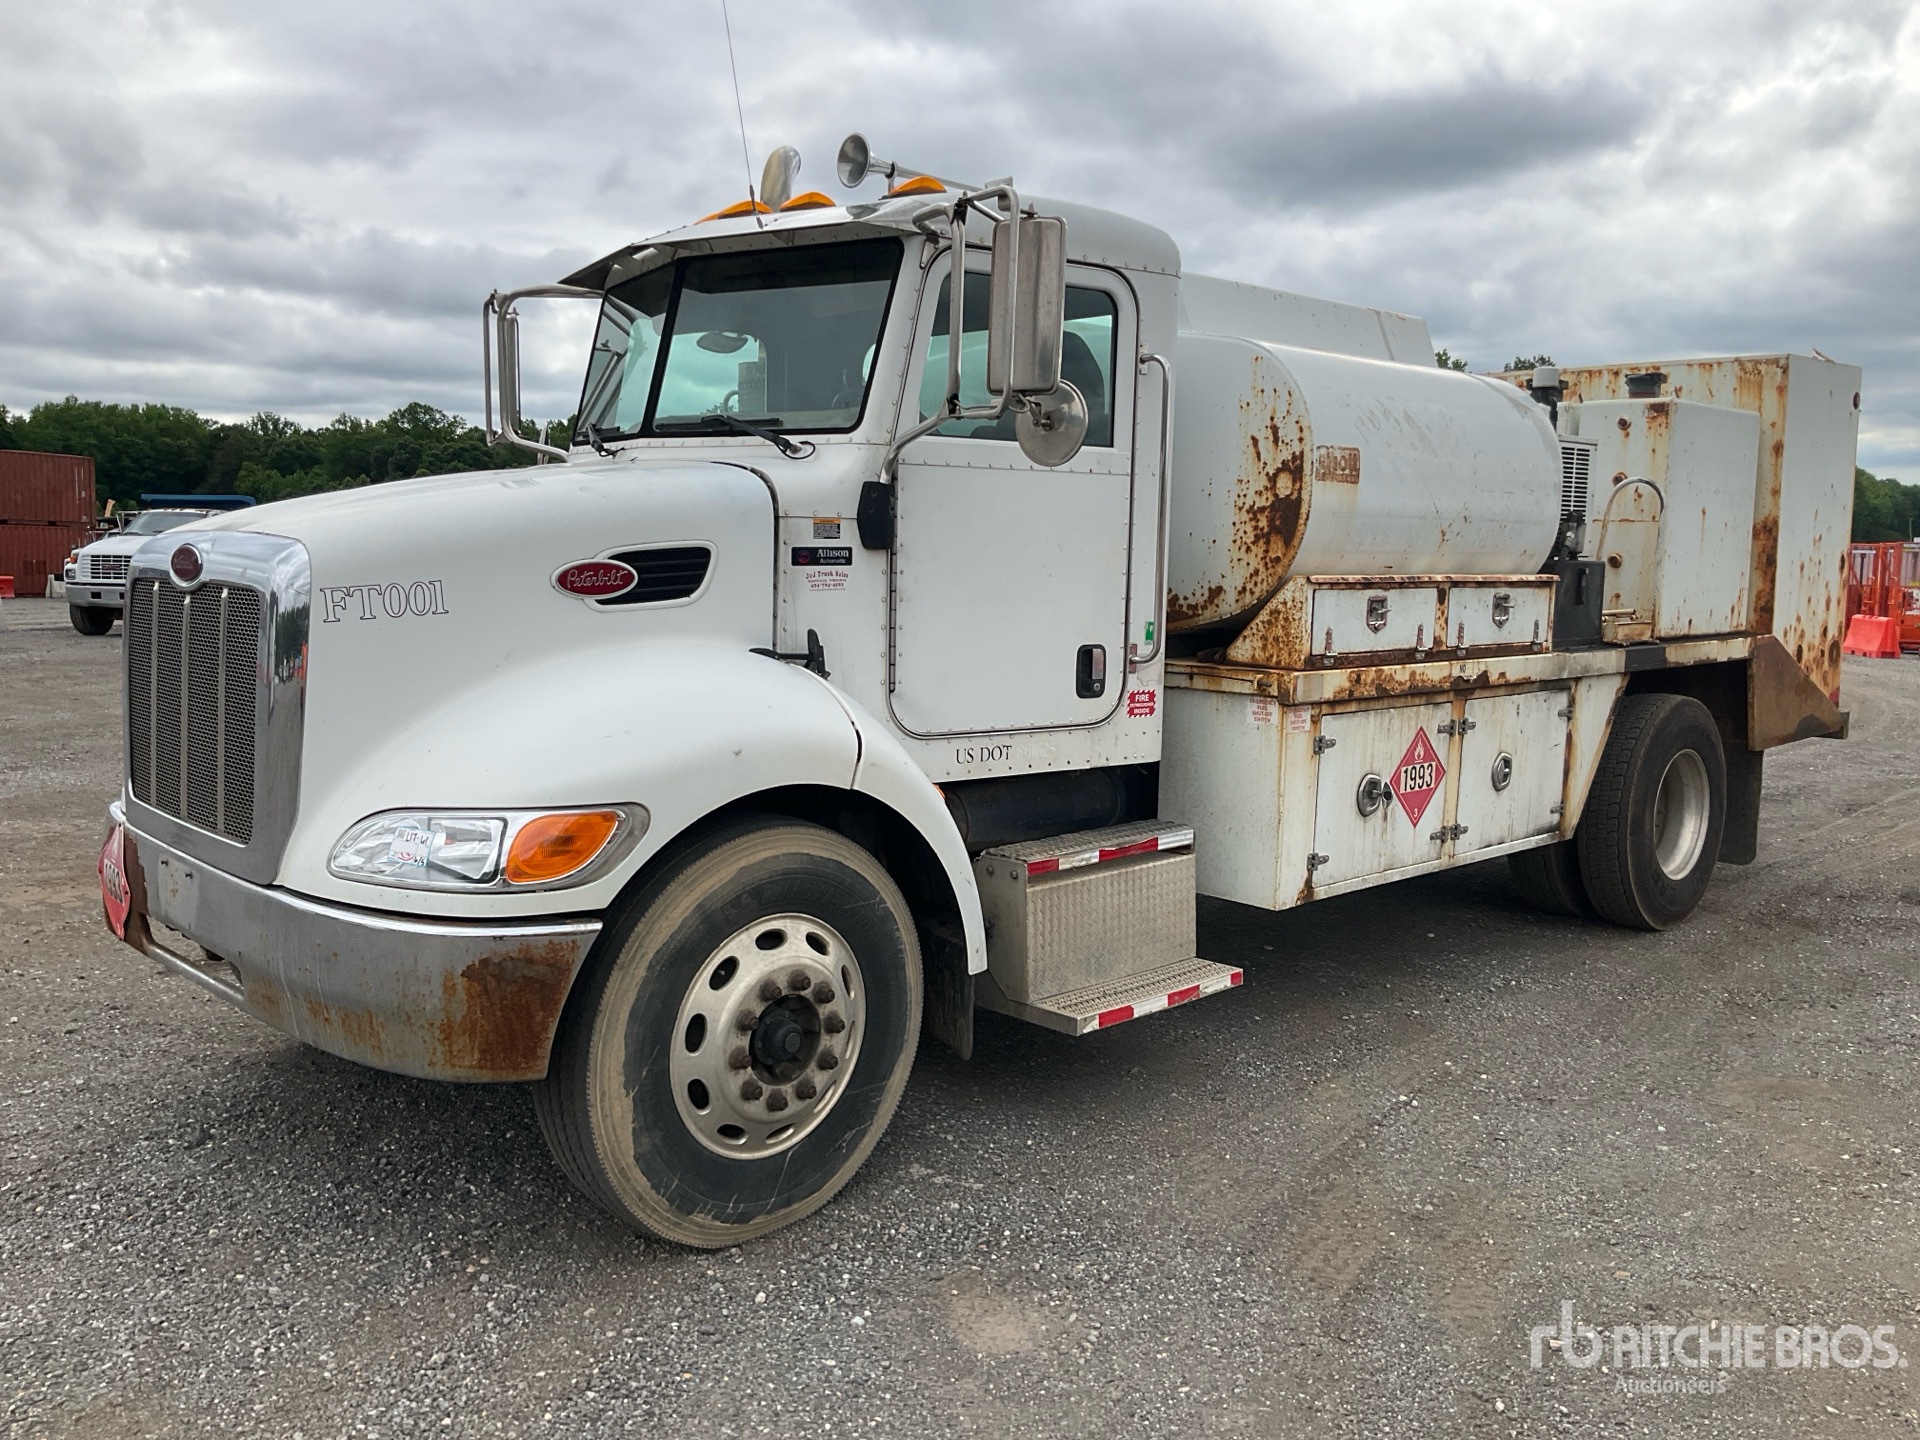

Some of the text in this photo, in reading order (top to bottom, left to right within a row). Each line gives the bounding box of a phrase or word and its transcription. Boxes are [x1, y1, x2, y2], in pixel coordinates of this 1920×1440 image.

[817, 549, 849, 557] Allison
[567, 568, 629, 589] Peterbilt
[817, 570, 834, 578] Truck
[835, 570, 849, 579] Sales
[319, 579, 450, 623] FT001
[1135, 694, 1150, 702] FIRE
[956, 747, 974, 765] US
[980, 744, 1013, 763] DOT
[1403, 762, 1433, 792] 1993
[1413, 808, 1418, 818] 3
